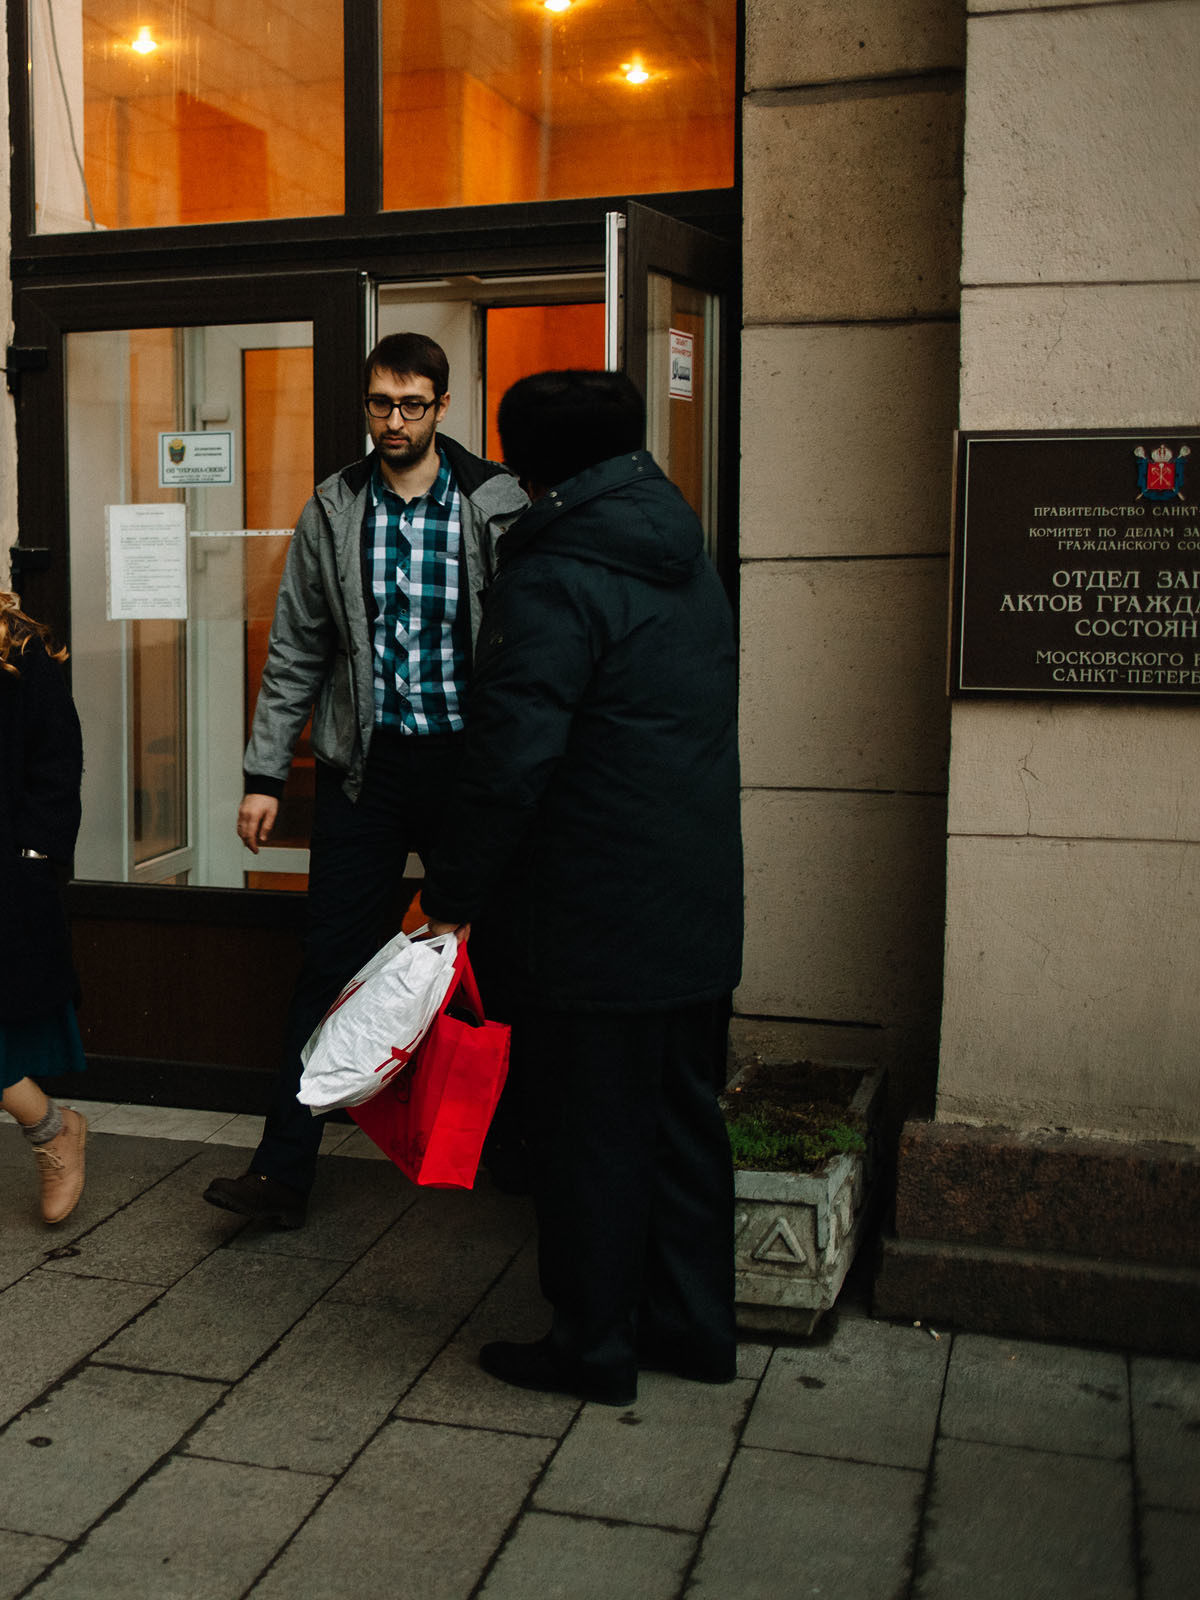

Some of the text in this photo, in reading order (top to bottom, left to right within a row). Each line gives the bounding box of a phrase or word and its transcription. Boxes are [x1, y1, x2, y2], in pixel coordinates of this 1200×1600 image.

[1034, 506, 1145, 517] ПРАВИТЕЛЬСТВО
[1029, 528, 1091, 538] КОМИТЕТ
[1099, 528, 1116, 537] ПО
[1125, 528, 1174, 538] ДЕЛАМ
[1058, 540, 1170, 551] ГРАЖДАНСКОГО
[1052, 570, 1140, 591] ОТДЕЛ
[1000, 594, 1083, 612] АКТОВ
[1075, 619, 1198, 638] СОСТОЯН
[1035, 651, 1184, 666] МОСКОВСКОГО
